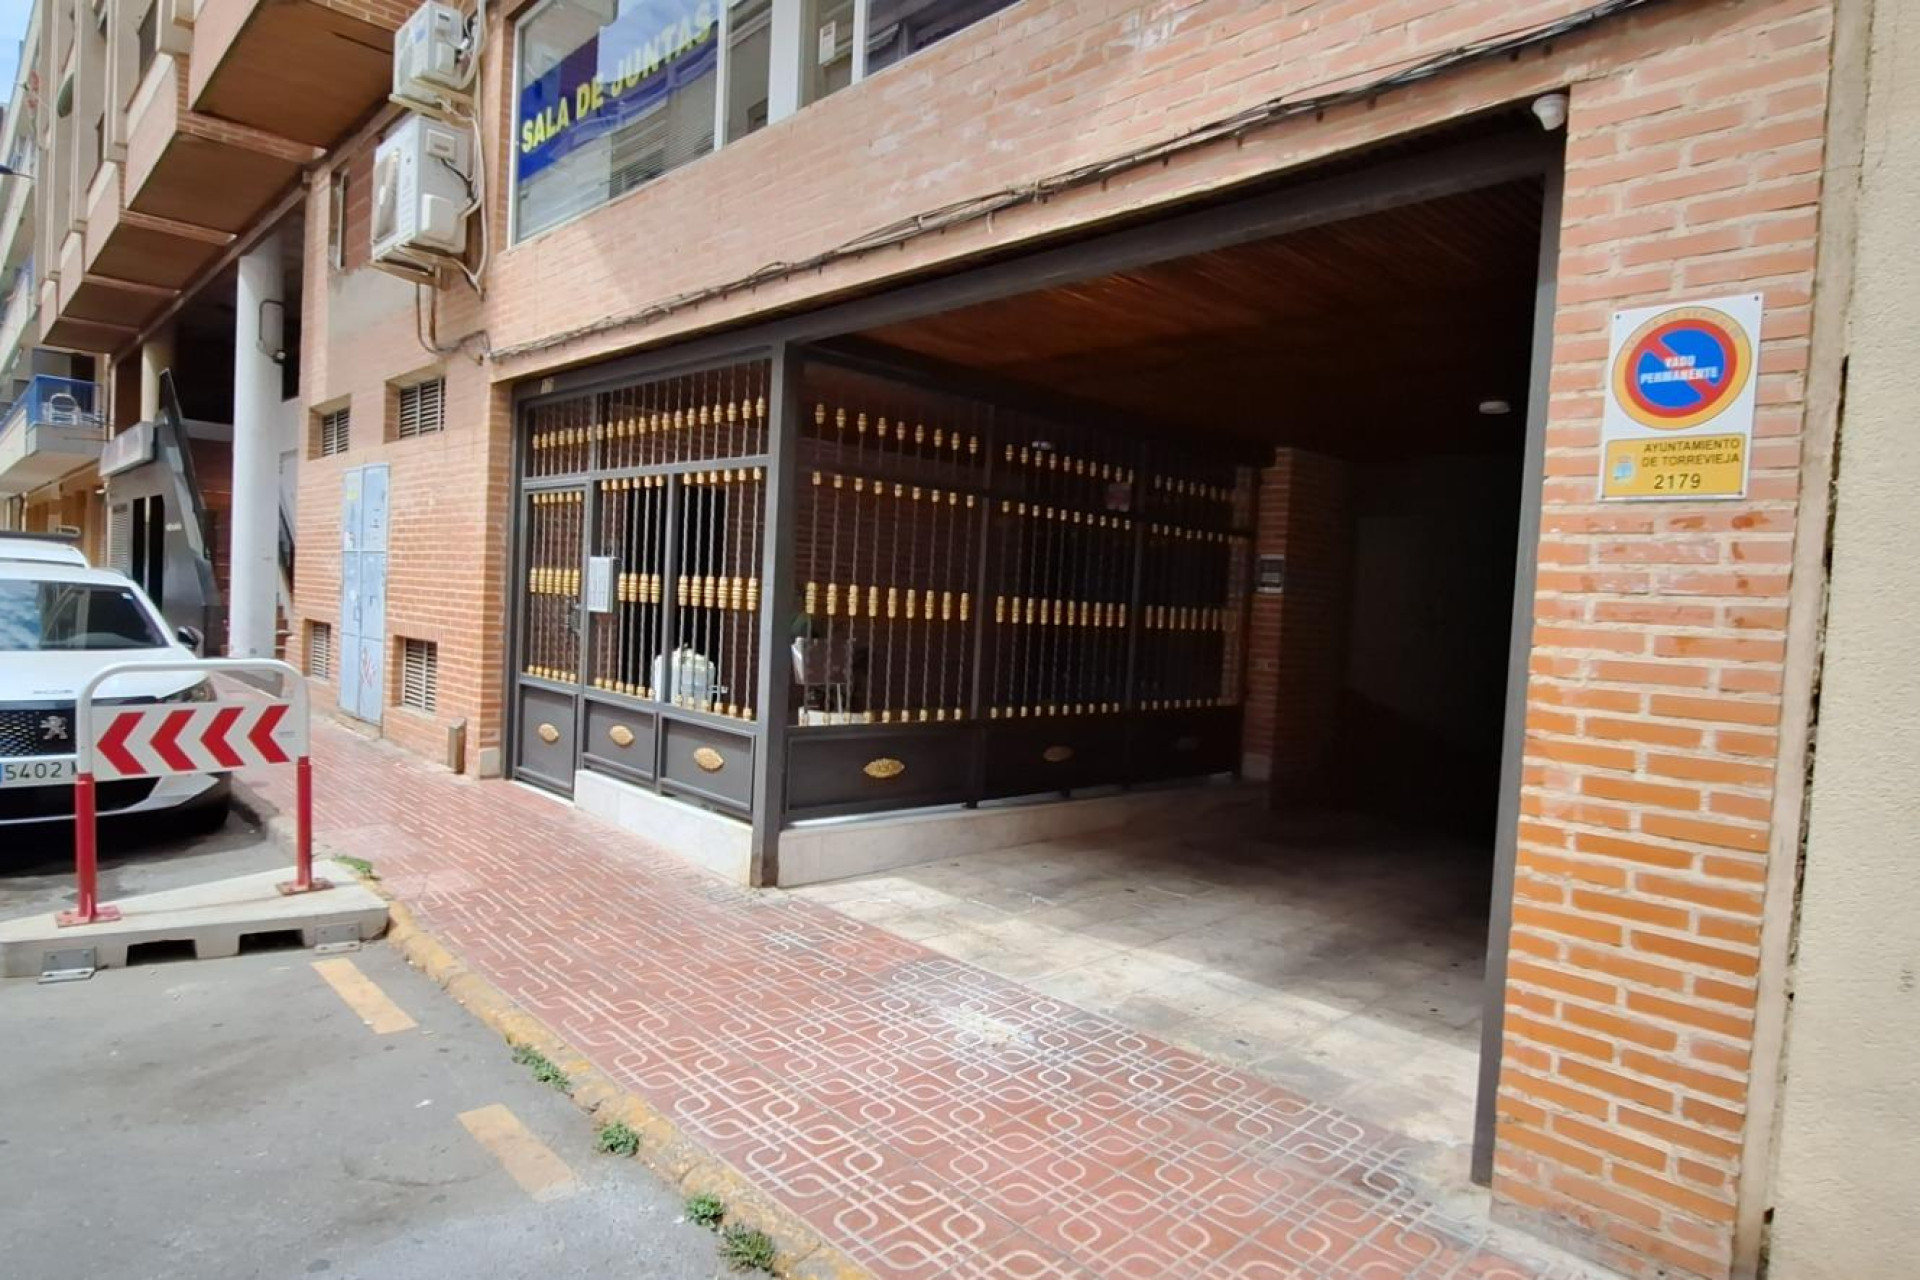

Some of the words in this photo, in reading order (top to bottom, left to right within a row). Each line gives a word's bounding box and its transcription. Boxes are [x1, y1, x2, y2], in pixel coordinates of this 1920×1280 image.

[522, 97, 569, 153] SALA
[576, 71, 604, 120] DE
[611, 2, 711, 97] JUNTAS
[1665, 355, 1696, 368] VADO
[1640, 366, 1718, 384] PERMANENTE
[1644, 438, 1740, 452] AYUNTAMIENTO
[1641, 457, 1658, 468] DE
[1662, 453, 1740, 466] TORREVIEJA
[1653, 473, 1701, 490] 2179
[5, 761, 62, 780] 5402
